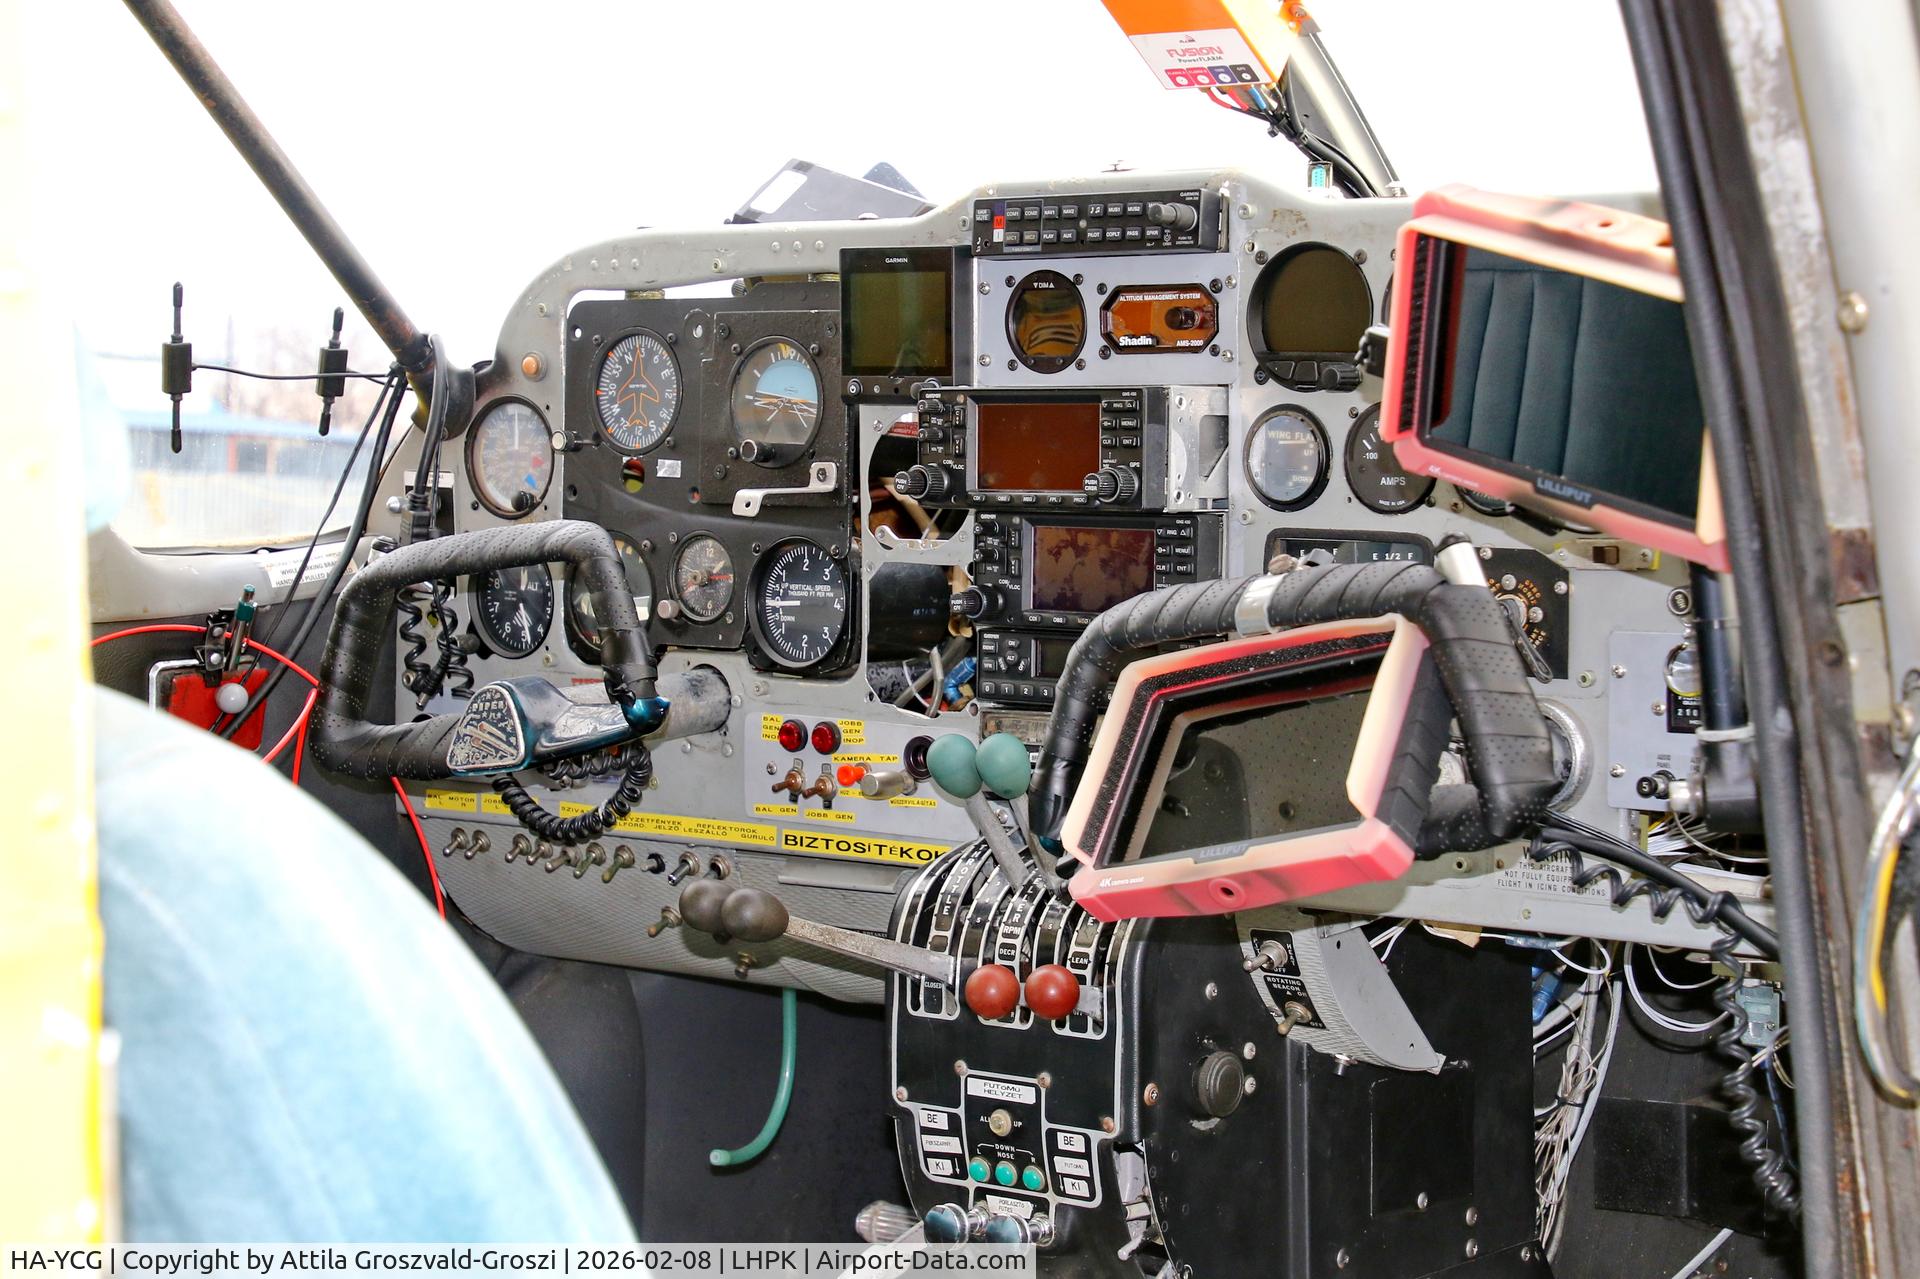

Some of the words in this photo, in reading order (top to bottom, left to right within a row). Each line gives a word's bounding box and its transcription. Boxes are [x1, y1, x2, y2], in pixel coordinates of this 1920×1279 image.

[1166, 46, 1224, 58] FUSION
[1119, 336, 1152, 346] Shadin
[1268, 430, 1291, 439] WING
[1363, 452, 1378, 460] -100
[1380, 476, 1406, 486] AMPS
[1536, 478, 1592, 503] LILLIPUT
[1373, 552, 1378, 560] E
[1385, 552, 1401, 560] 1/2
[802, 558, 809, 571] 2
[822, 568, 830, 580] 3
[494, 578, 500, 589] 8
[527, 581, 538, 591] ALT
[494, 602, 500, 613] 7
[706, 600, 713, 609] 6
[834, 598, 840, 610] 4
[505, 622, 512, 633] 6
[822, 626, 830, 638] 3
[521, 630, 527, 642] 5
[802, 634, 808, 647] 2
[472, 700, 504, 712] PIPER
[1642, 781, 1649, 792] 5
[696, 823, 758, 834] REFLEKTOROK
[1200, 844, 1249, 858] LILLIPUT
[1520, 862, 1535, 870] THIS
[1522, 872, 1542, 880] FULLY
[1100, 878, 1112, 888] 4K
[1538, 884, 1557, 892] ICING
[1002, 926, 1021, 936] RPM
[1000, 948, 1016, 956] DECR
[1266, 976, 1302, 986] ROTATING
[984, 1089, 1024, 1100] HELYZET
[927, 1114, 938, 1124] BE
[1064, 1136, 1074, 1146] BE
[994, 1144, 1016, 1152] DOWN
[998, 1152, 1015, 1160] NOSE
[935, 1161, 945, 1170] KI
[1071, 1182, 1080, 1191] KI
